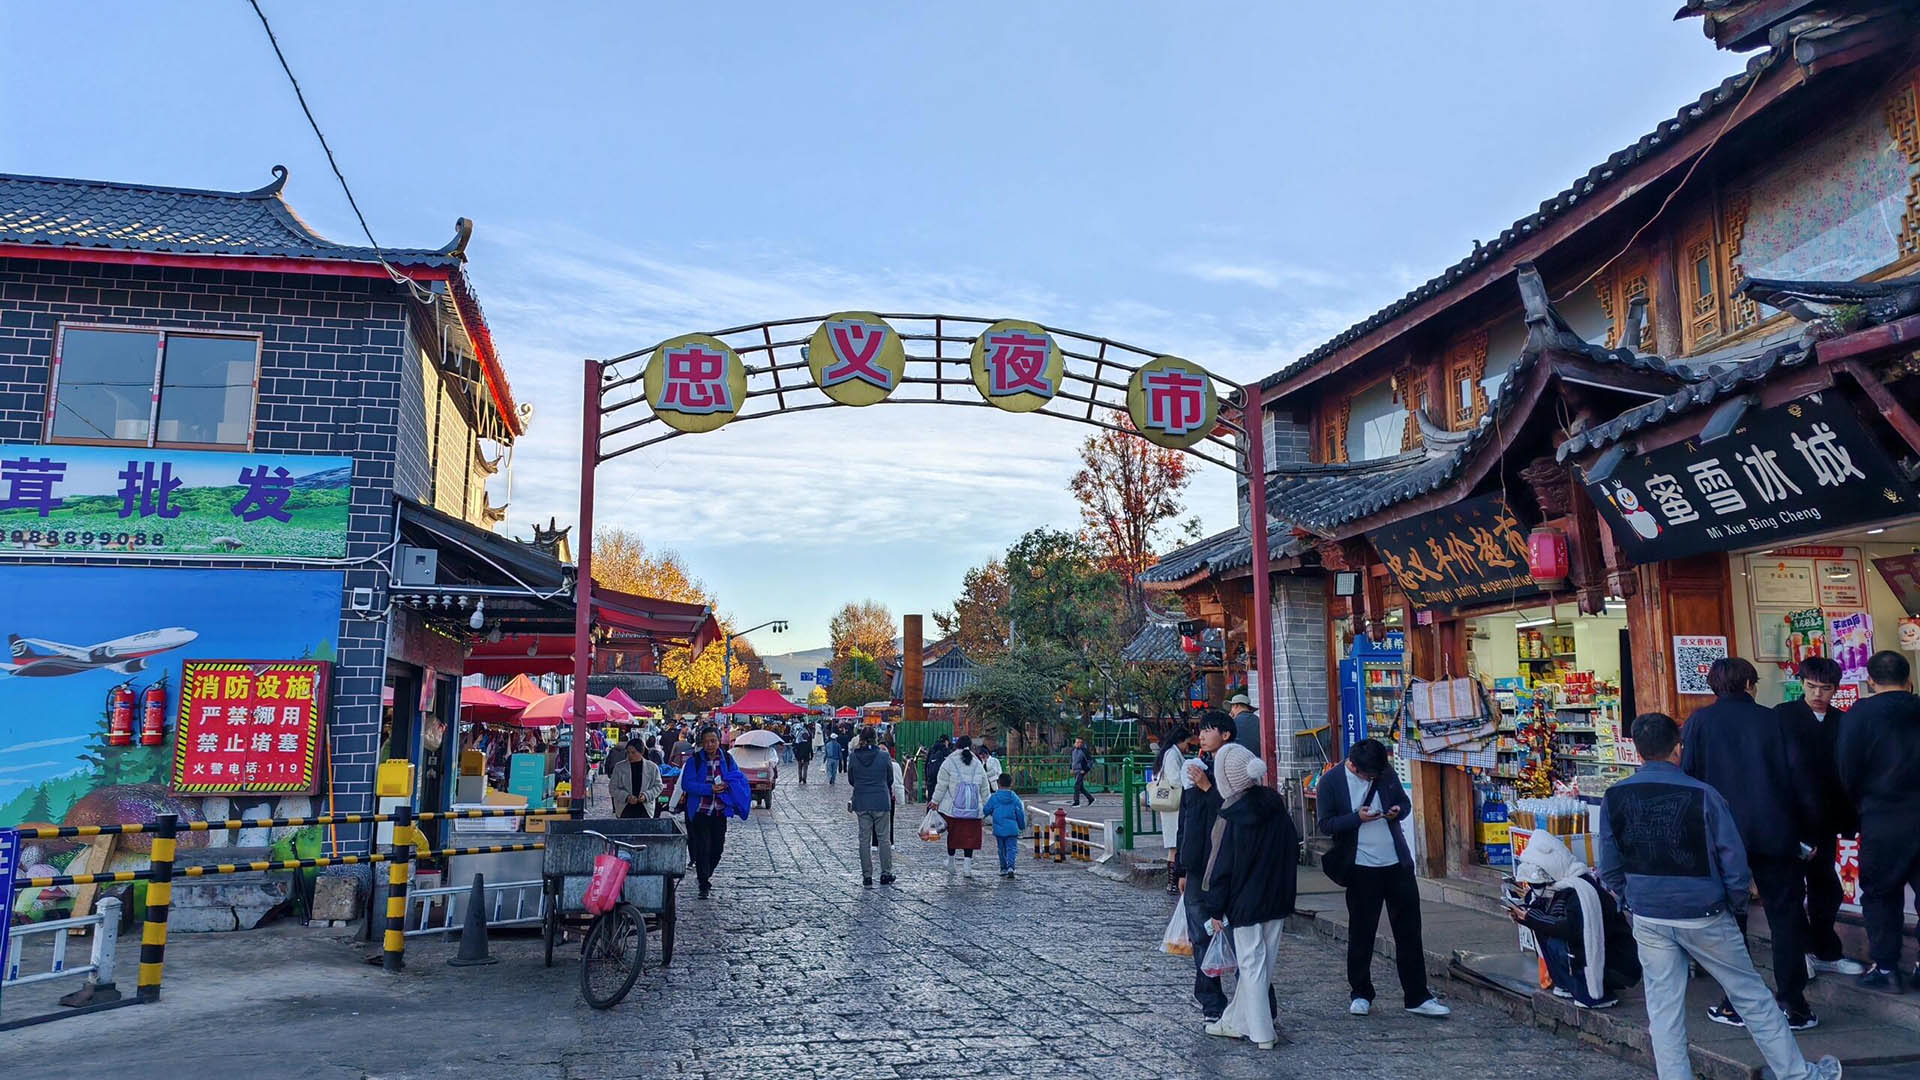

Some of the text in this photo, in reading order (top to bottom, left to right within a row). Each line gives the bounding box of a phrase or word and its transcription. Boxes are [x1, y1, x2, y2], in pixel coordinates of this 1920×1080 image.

[664, 320, 1206, 432] 忠义夜市
[1645, 421, 1866, 526] 蜜雪冰城
[0, 456, 294, 523] 茸批发
[1706, 504, 1822, 540] Mi Xue Bing Cheng
[1482, 574, 1535, 593] supermarke
[193, 675, 314, 701] 消防设施
[199, 705, 302, 727] 严禁挪用
[196, 732, 299, 754] 禁止堵塞
